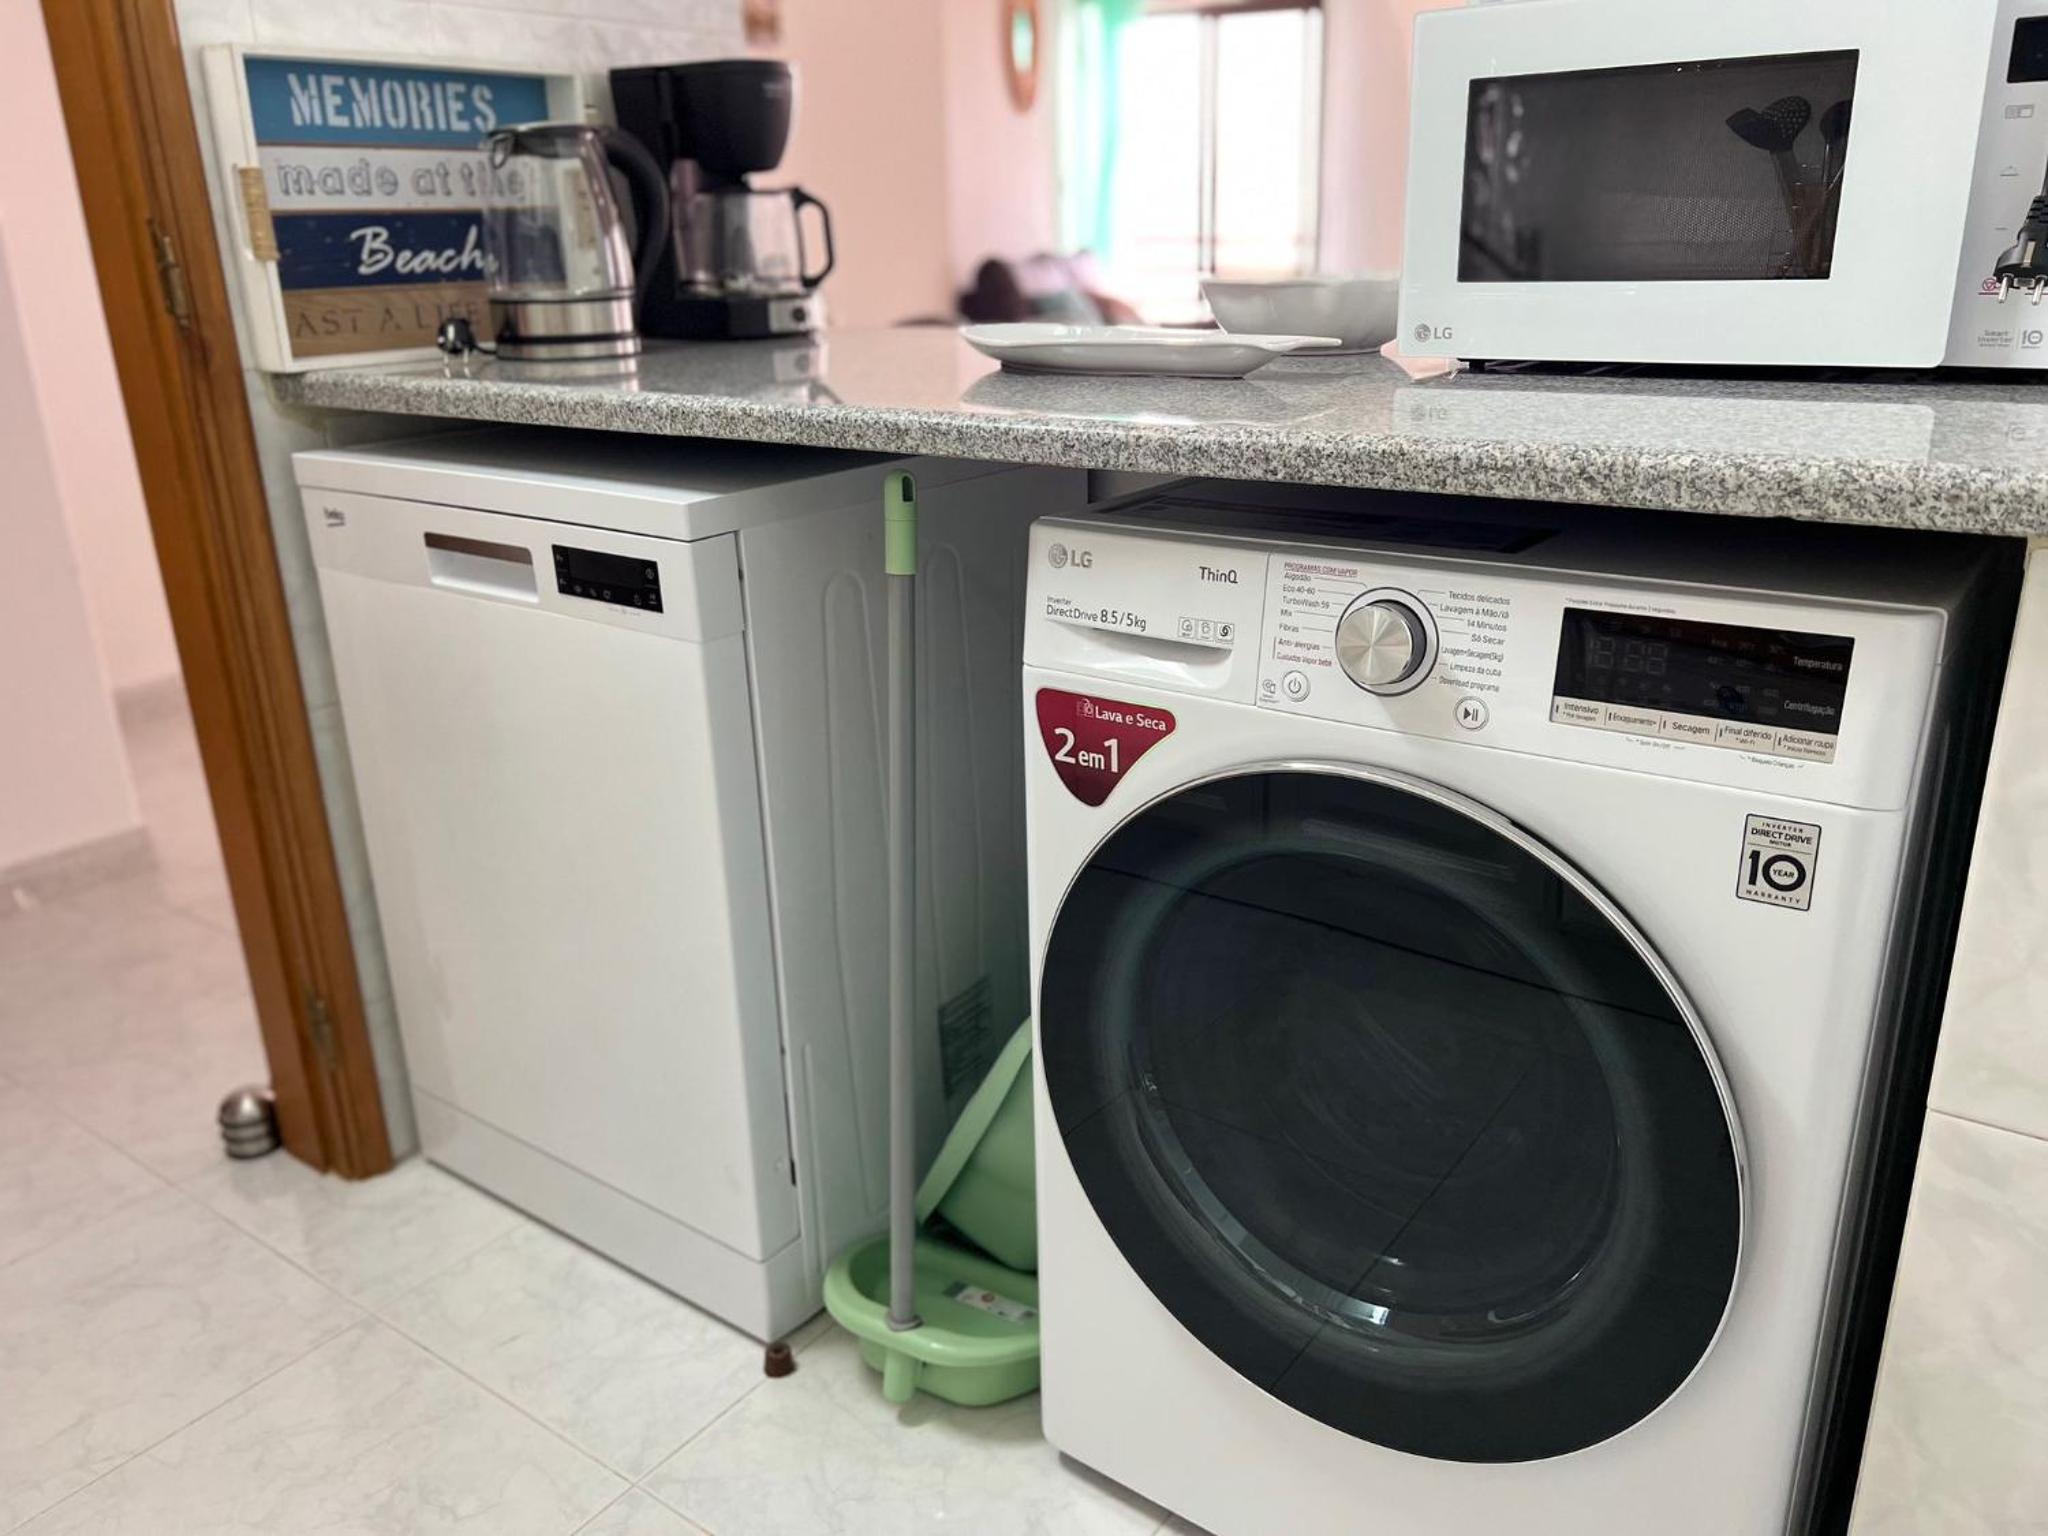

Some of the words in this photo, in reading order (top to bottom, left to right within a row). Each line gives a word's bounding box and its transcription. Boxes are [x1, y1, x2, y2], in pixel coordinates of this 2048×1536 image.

[288, 72, 498, 133] MEMORIES
[278, 158, 399, 196] made
[413, 161, 453, 197] at
[350, 223, 492, 276] Beach
[1433, 326, 1454, 340] LG
[1070, 551, 1093, 568] LG
[1199, 566, 1239, 584] ThinQ
[1440, 603, 1474, 615] Lavagem
[1467, 619, 1476, 627] 14
[1476, 620, 1508, 632] Minutos
[1482, 635, 1505, 646] Secar
[1793, 655, 1843, 672] Temperatura
[1564, 702, 1600, 715] Intensivo
[1095, 705, 1123, 724] Lava
[1125, 715, 1134, 725] e
[1136, 713, 1167, 731] Seca
[1671, 721, 1711, 736] Secagem
[1725, 725, 1742, 736] Final
[1743, 728, 1772, 741] diferido
[1783, 734, 1814, 747] Adicionar
[1814, 738, 1835, 750] roupa
[1054, 727, 1076, 764] 2
[1078, 750, 1105, 770] em
[1103, 738, 1119, 774] 1
[1762, 822, 1803, 833] INVERTER
[1751, 828, 1783, 839] DIRECT
[1784, 833, 1813, 845] DRIVE
[1748, 850, 1806, 892] 10
[1772, 868, 1795, 879] YEAR
[1746, 890, 1800, 904] WARRANTY
